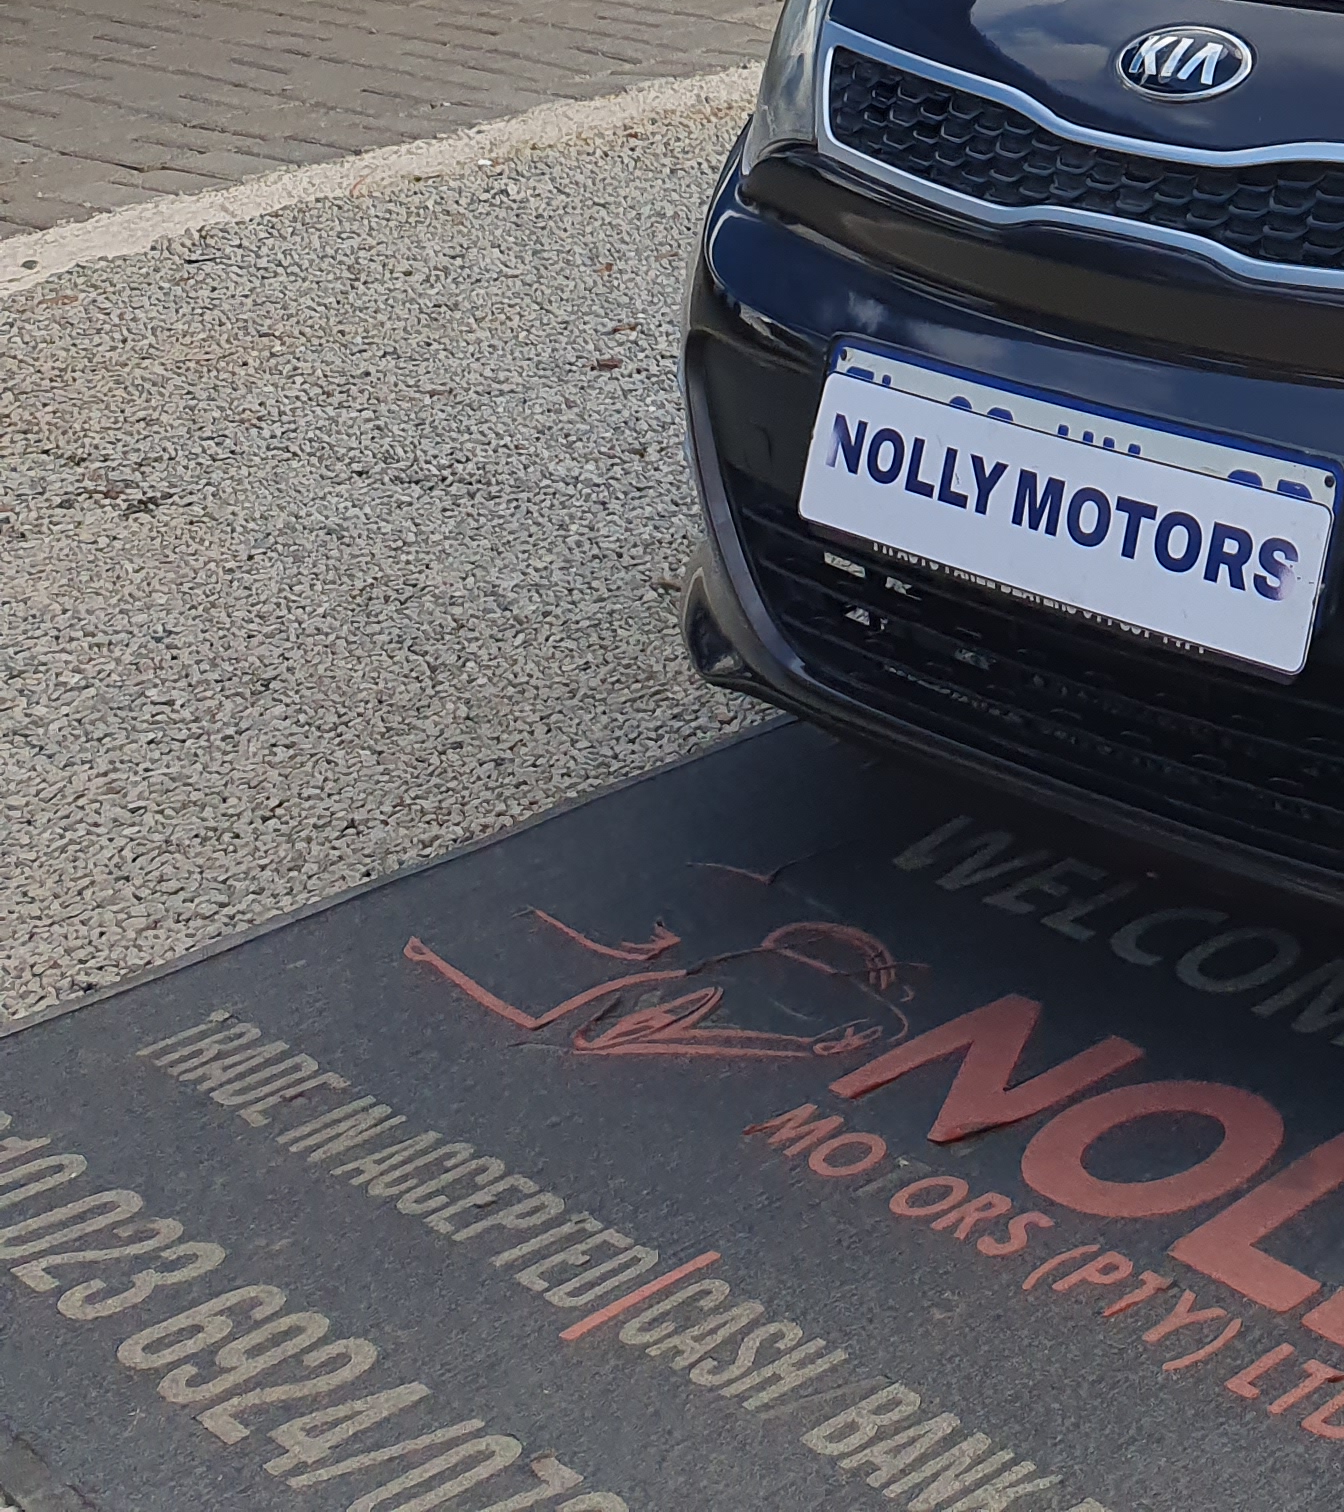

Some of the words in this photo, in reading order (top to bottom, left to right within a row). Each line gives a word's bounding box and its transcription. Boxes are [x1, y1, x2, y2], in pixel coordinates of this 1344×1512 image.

[1128, 34, 1225, 87] KIA
[825, 412, 1009, 516] NOLLY
[1011, 467, 1300, 602] MOTORS
[136, 1009, 352, 1128] TRADE
[276, 1094, 407, 1163] IN
[1022, 1243, 1242, 1371] (PTY)
